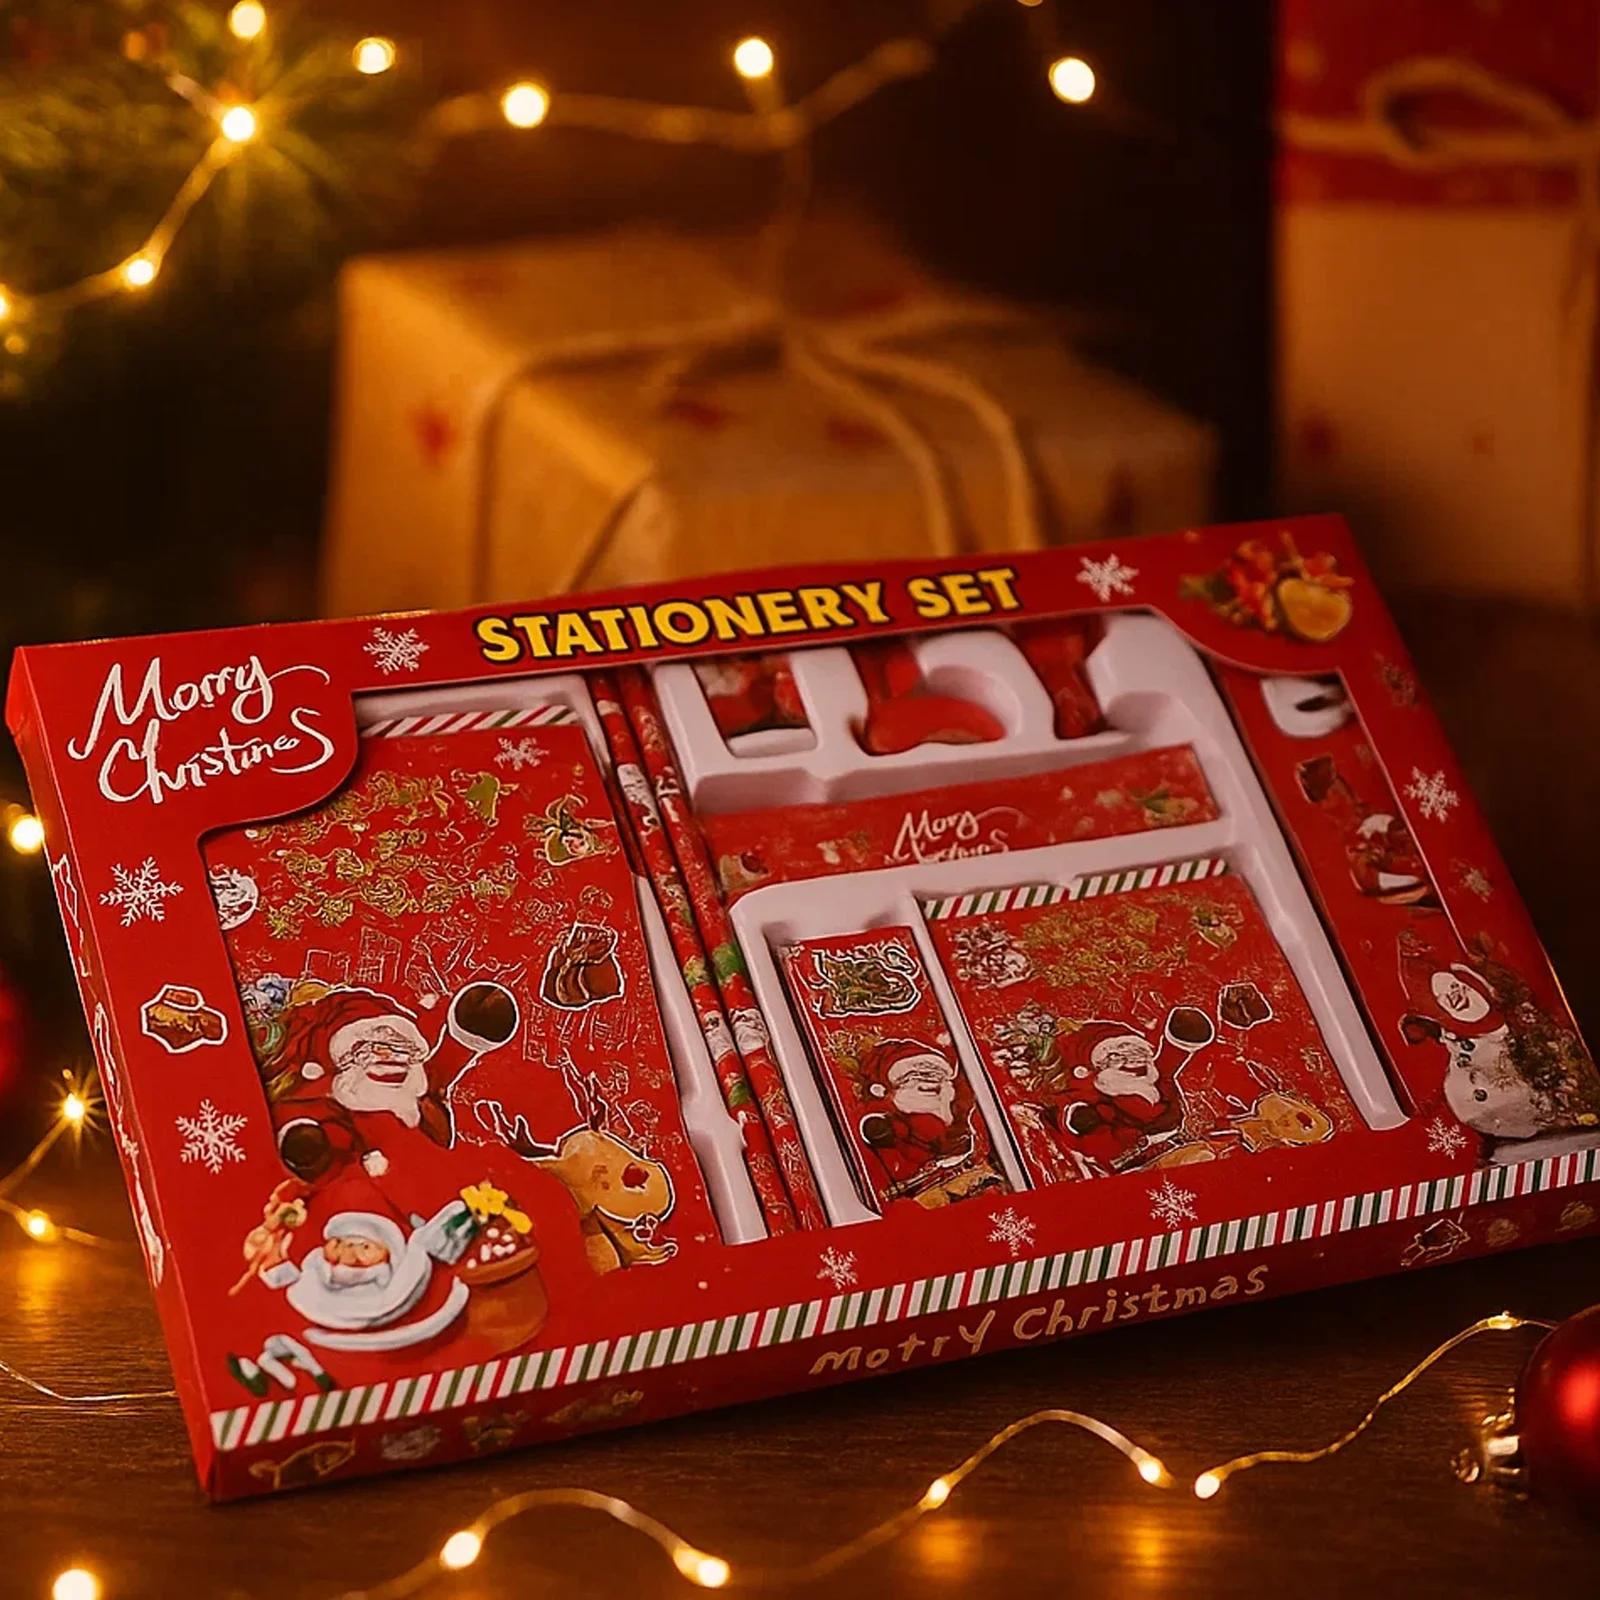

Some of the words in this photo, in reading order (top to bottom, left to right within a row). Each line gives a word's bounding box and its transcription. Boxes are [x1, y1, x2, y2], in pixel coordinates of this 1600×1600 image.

[475, 580, 892, 663] STATIONERY
[906, 566, 1021, 619] SET
[1013, 1264, 1269, 1340] Christmas
